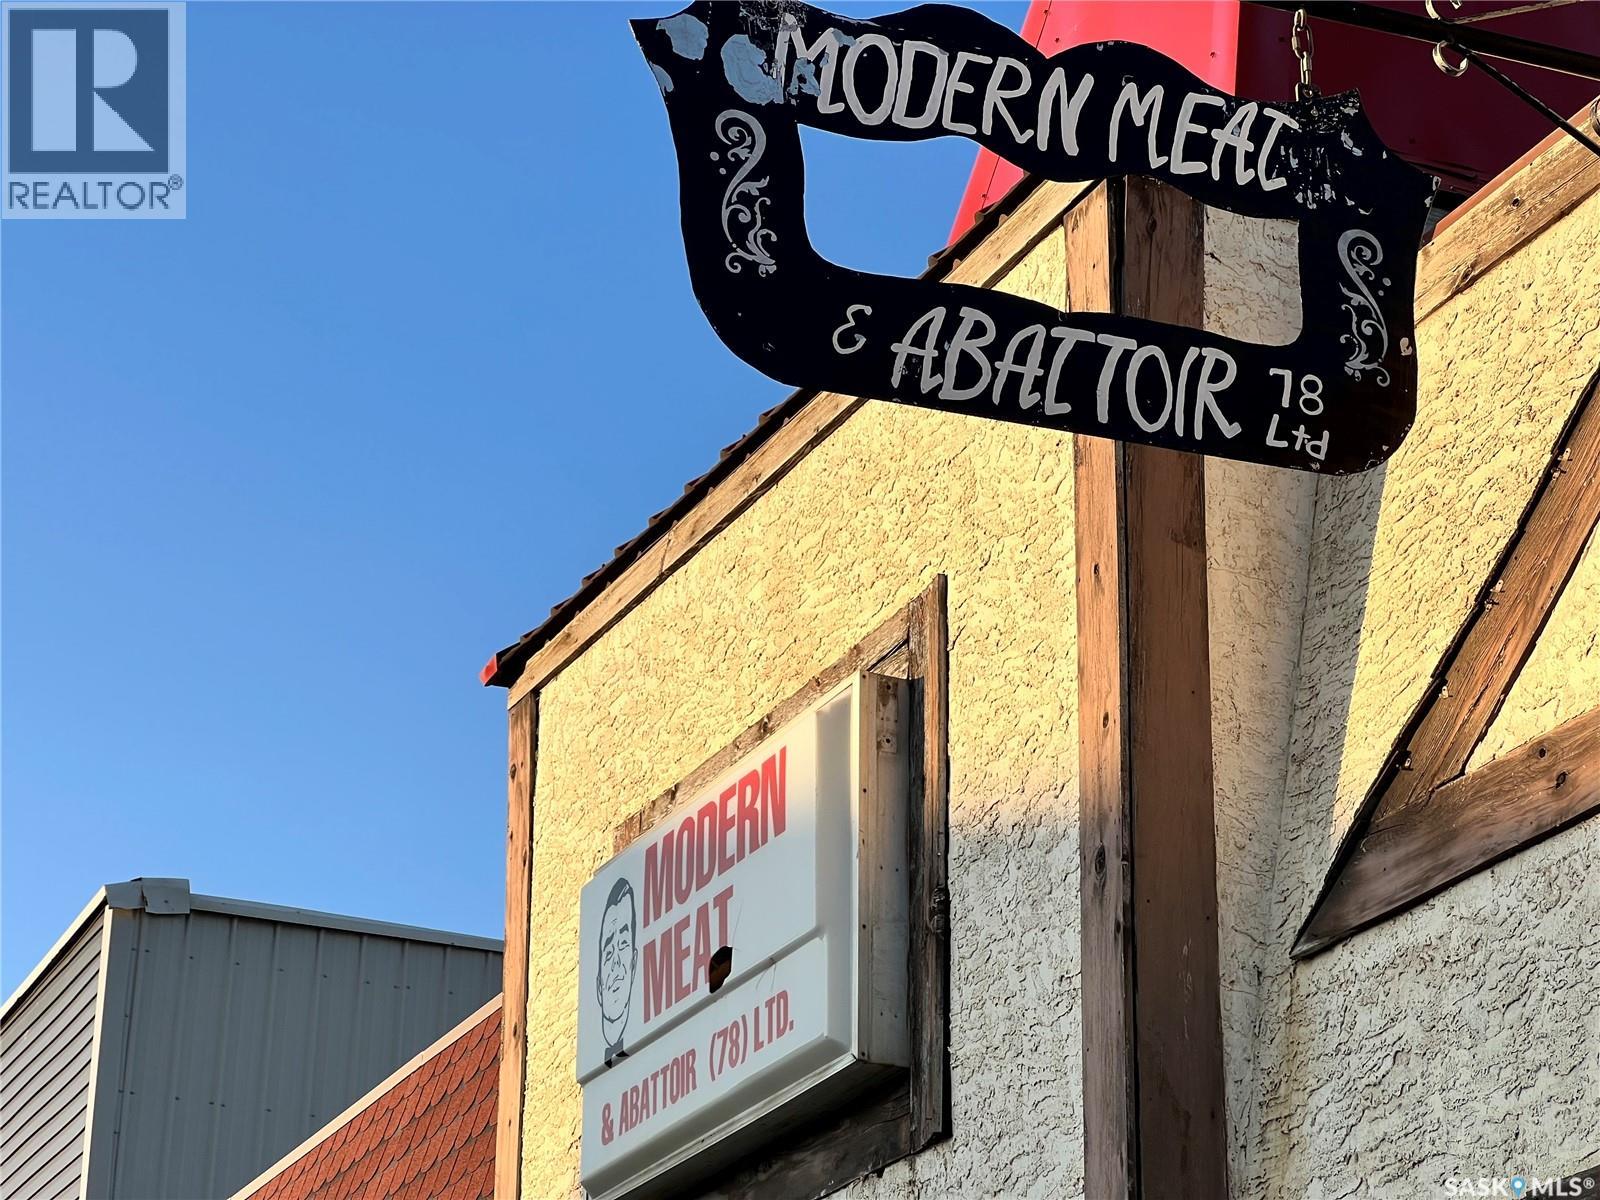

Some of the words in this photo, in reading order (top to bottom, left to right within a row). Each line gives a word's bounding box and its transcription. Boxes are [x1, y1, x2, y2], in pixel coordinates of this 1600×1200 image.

[774, 12, 1094, 156] MODERN
[1108, 82, 1300, 191] MEAT
[890, 306, 1242, 439] ABATTOIR
[1266, 414, 1330, 461] Ltd
[1269, 367, 1324, 416] 78
[642, 745, 787, 929] MODERN
[642, 884, 735, 1024] MEAT
[601, 1102, 614, 1146] &
[618, 1048, 697, 1135] ABATTOIR
[709, 1013, 748, 1082] (78)
[753, 988, 795, 1053] LTD.
